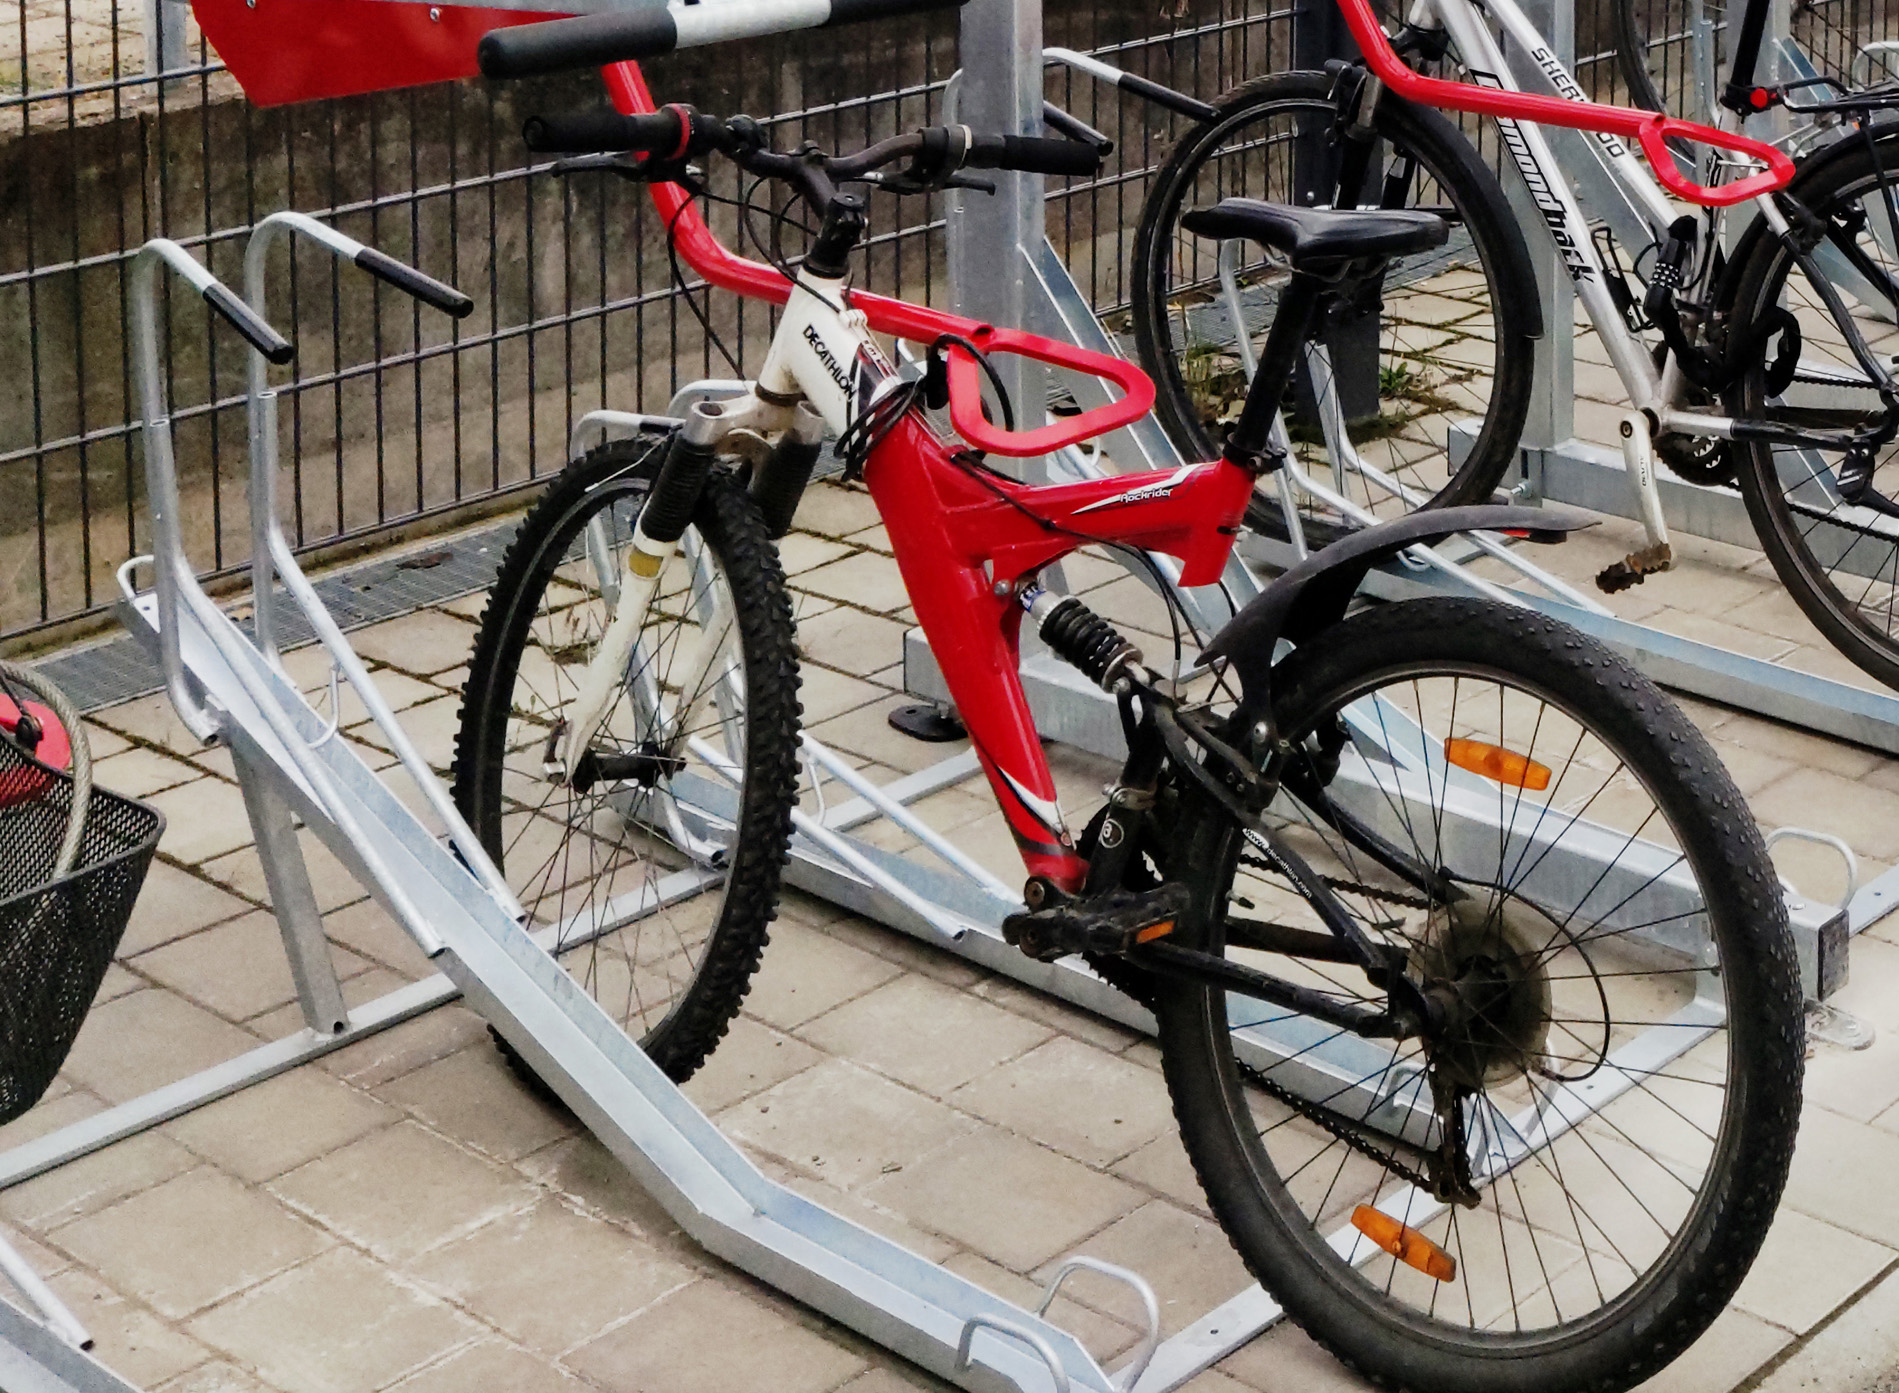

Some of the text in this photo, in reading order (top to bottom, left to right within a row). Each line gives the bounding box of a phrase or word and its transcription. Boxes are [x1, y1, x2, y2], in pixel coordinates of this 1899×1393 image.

[802, 323, 857, 401] DECATHLON
[1120, 487, 1173, 504] Rockrider
[1245, 828, 1313, 899] www.decathlon.com
